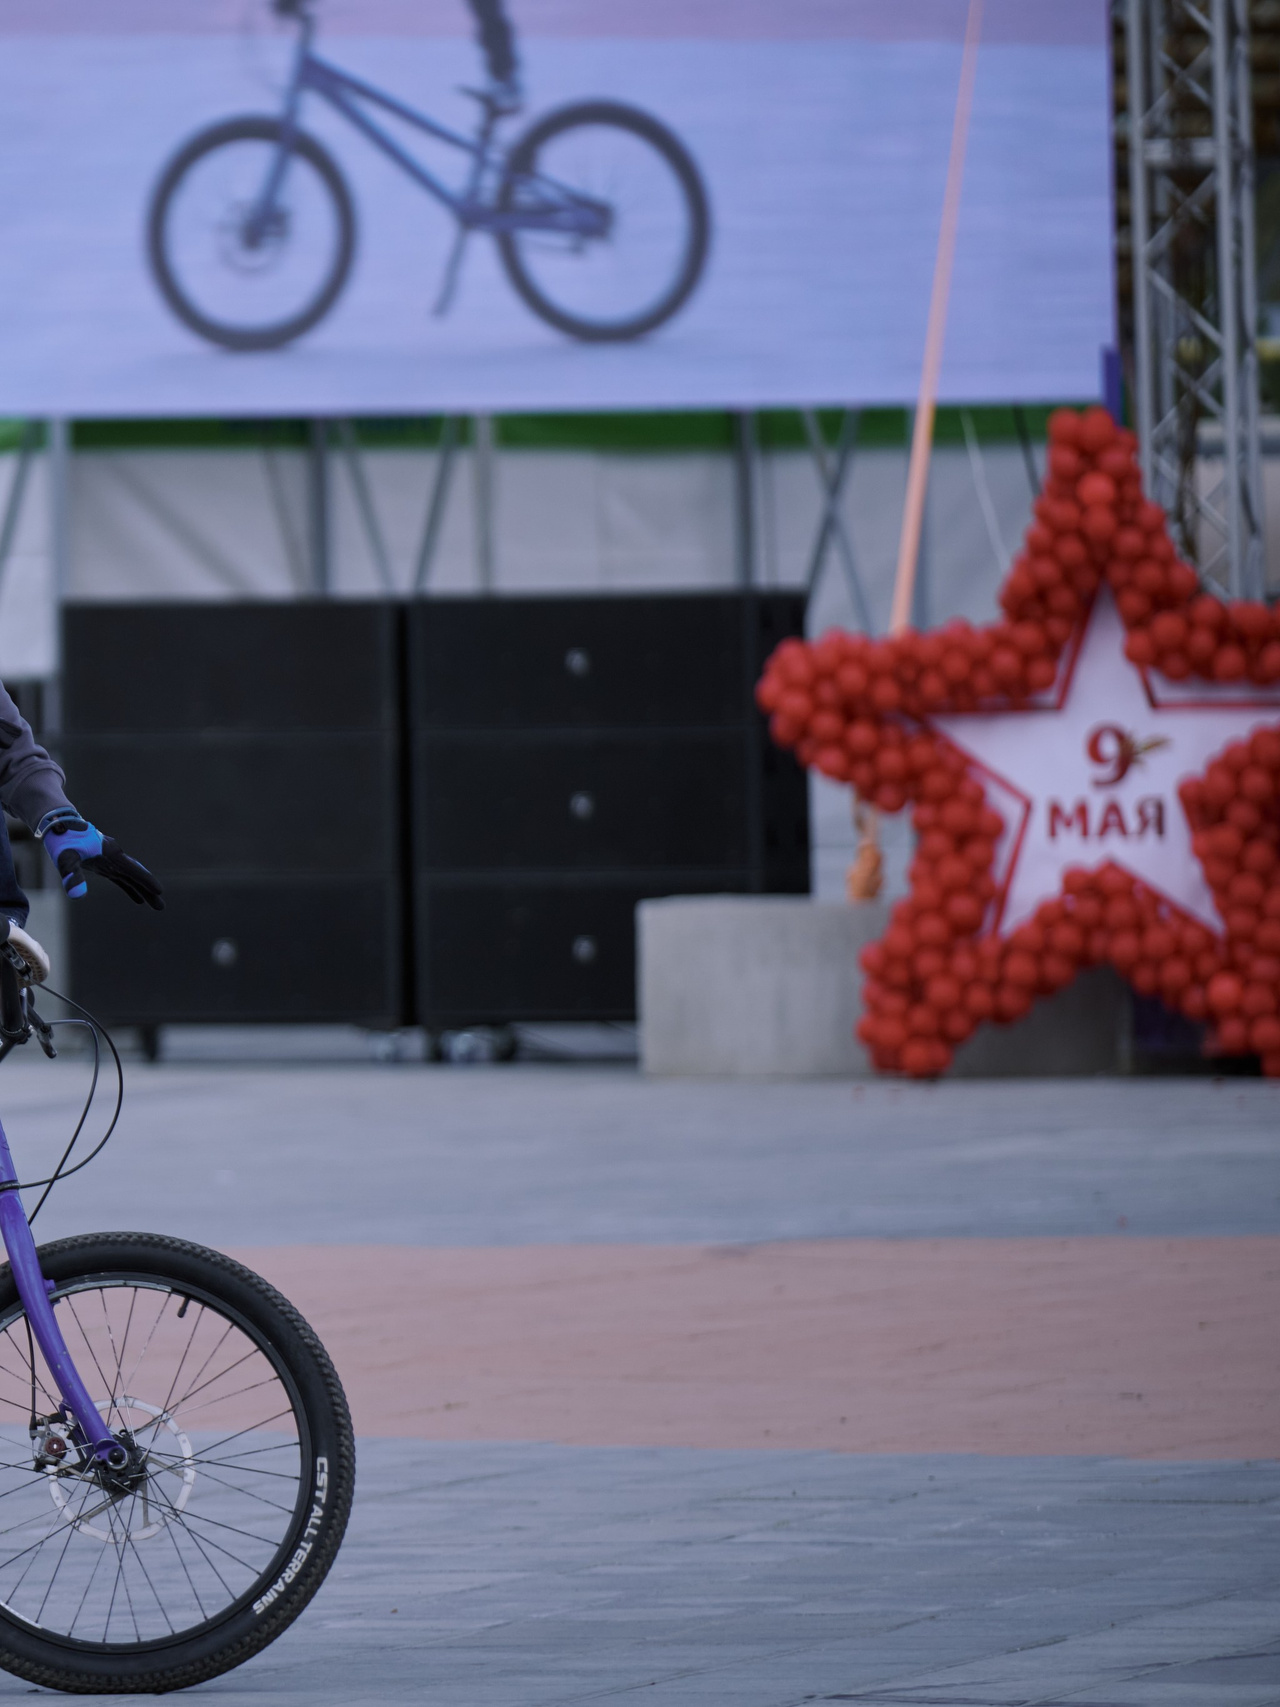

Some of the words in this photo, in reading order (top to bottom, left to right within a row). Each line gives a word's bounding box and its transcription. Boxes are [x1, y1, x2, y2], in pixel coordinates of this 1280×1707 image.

[1086, 722, 1136, 787] 9
[1047, 800, 1165, 839] МАЯ
[315, 1456, 329, 1504] CST
[304, 1504, 324, 1538] ALL
[252, 1541, 313, 1615] TERRAINS
